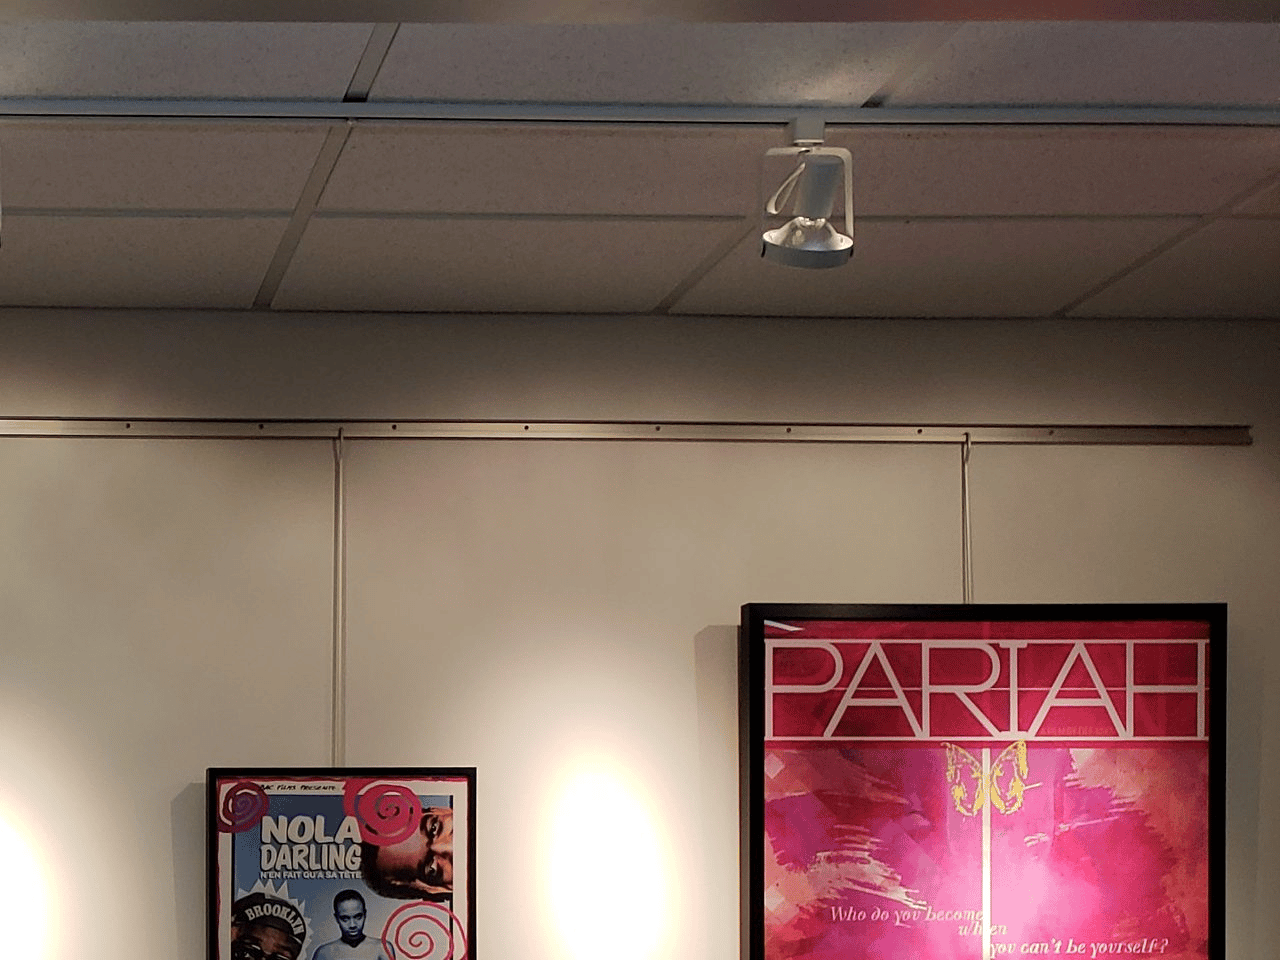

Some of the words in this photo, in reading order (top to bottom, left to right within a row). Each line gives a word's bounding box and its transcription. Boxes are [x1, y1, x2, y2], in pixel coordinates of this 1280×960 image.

[764, 639, 1209, 741] PARIAH
[261, 815, 363, 844] NOLA
[261, 844, 362, 871] DARLING
[283, 871, 301, 879] FAIT
[325, 871, 338, 879] SA
[245, 903, 305, 937] BROOKLYN
[831, 906, 867, 922] Who
[871, 906, 890, 922] do
[894, 909, 921, 929] you
[925, 906, 984, 922] become
[990, 943, 1017, 960] you
[1020, 938, 1062, 954] can't
[1066, 938, 1086, 954] be
[1090, 938, 1169, 960] yourself?
